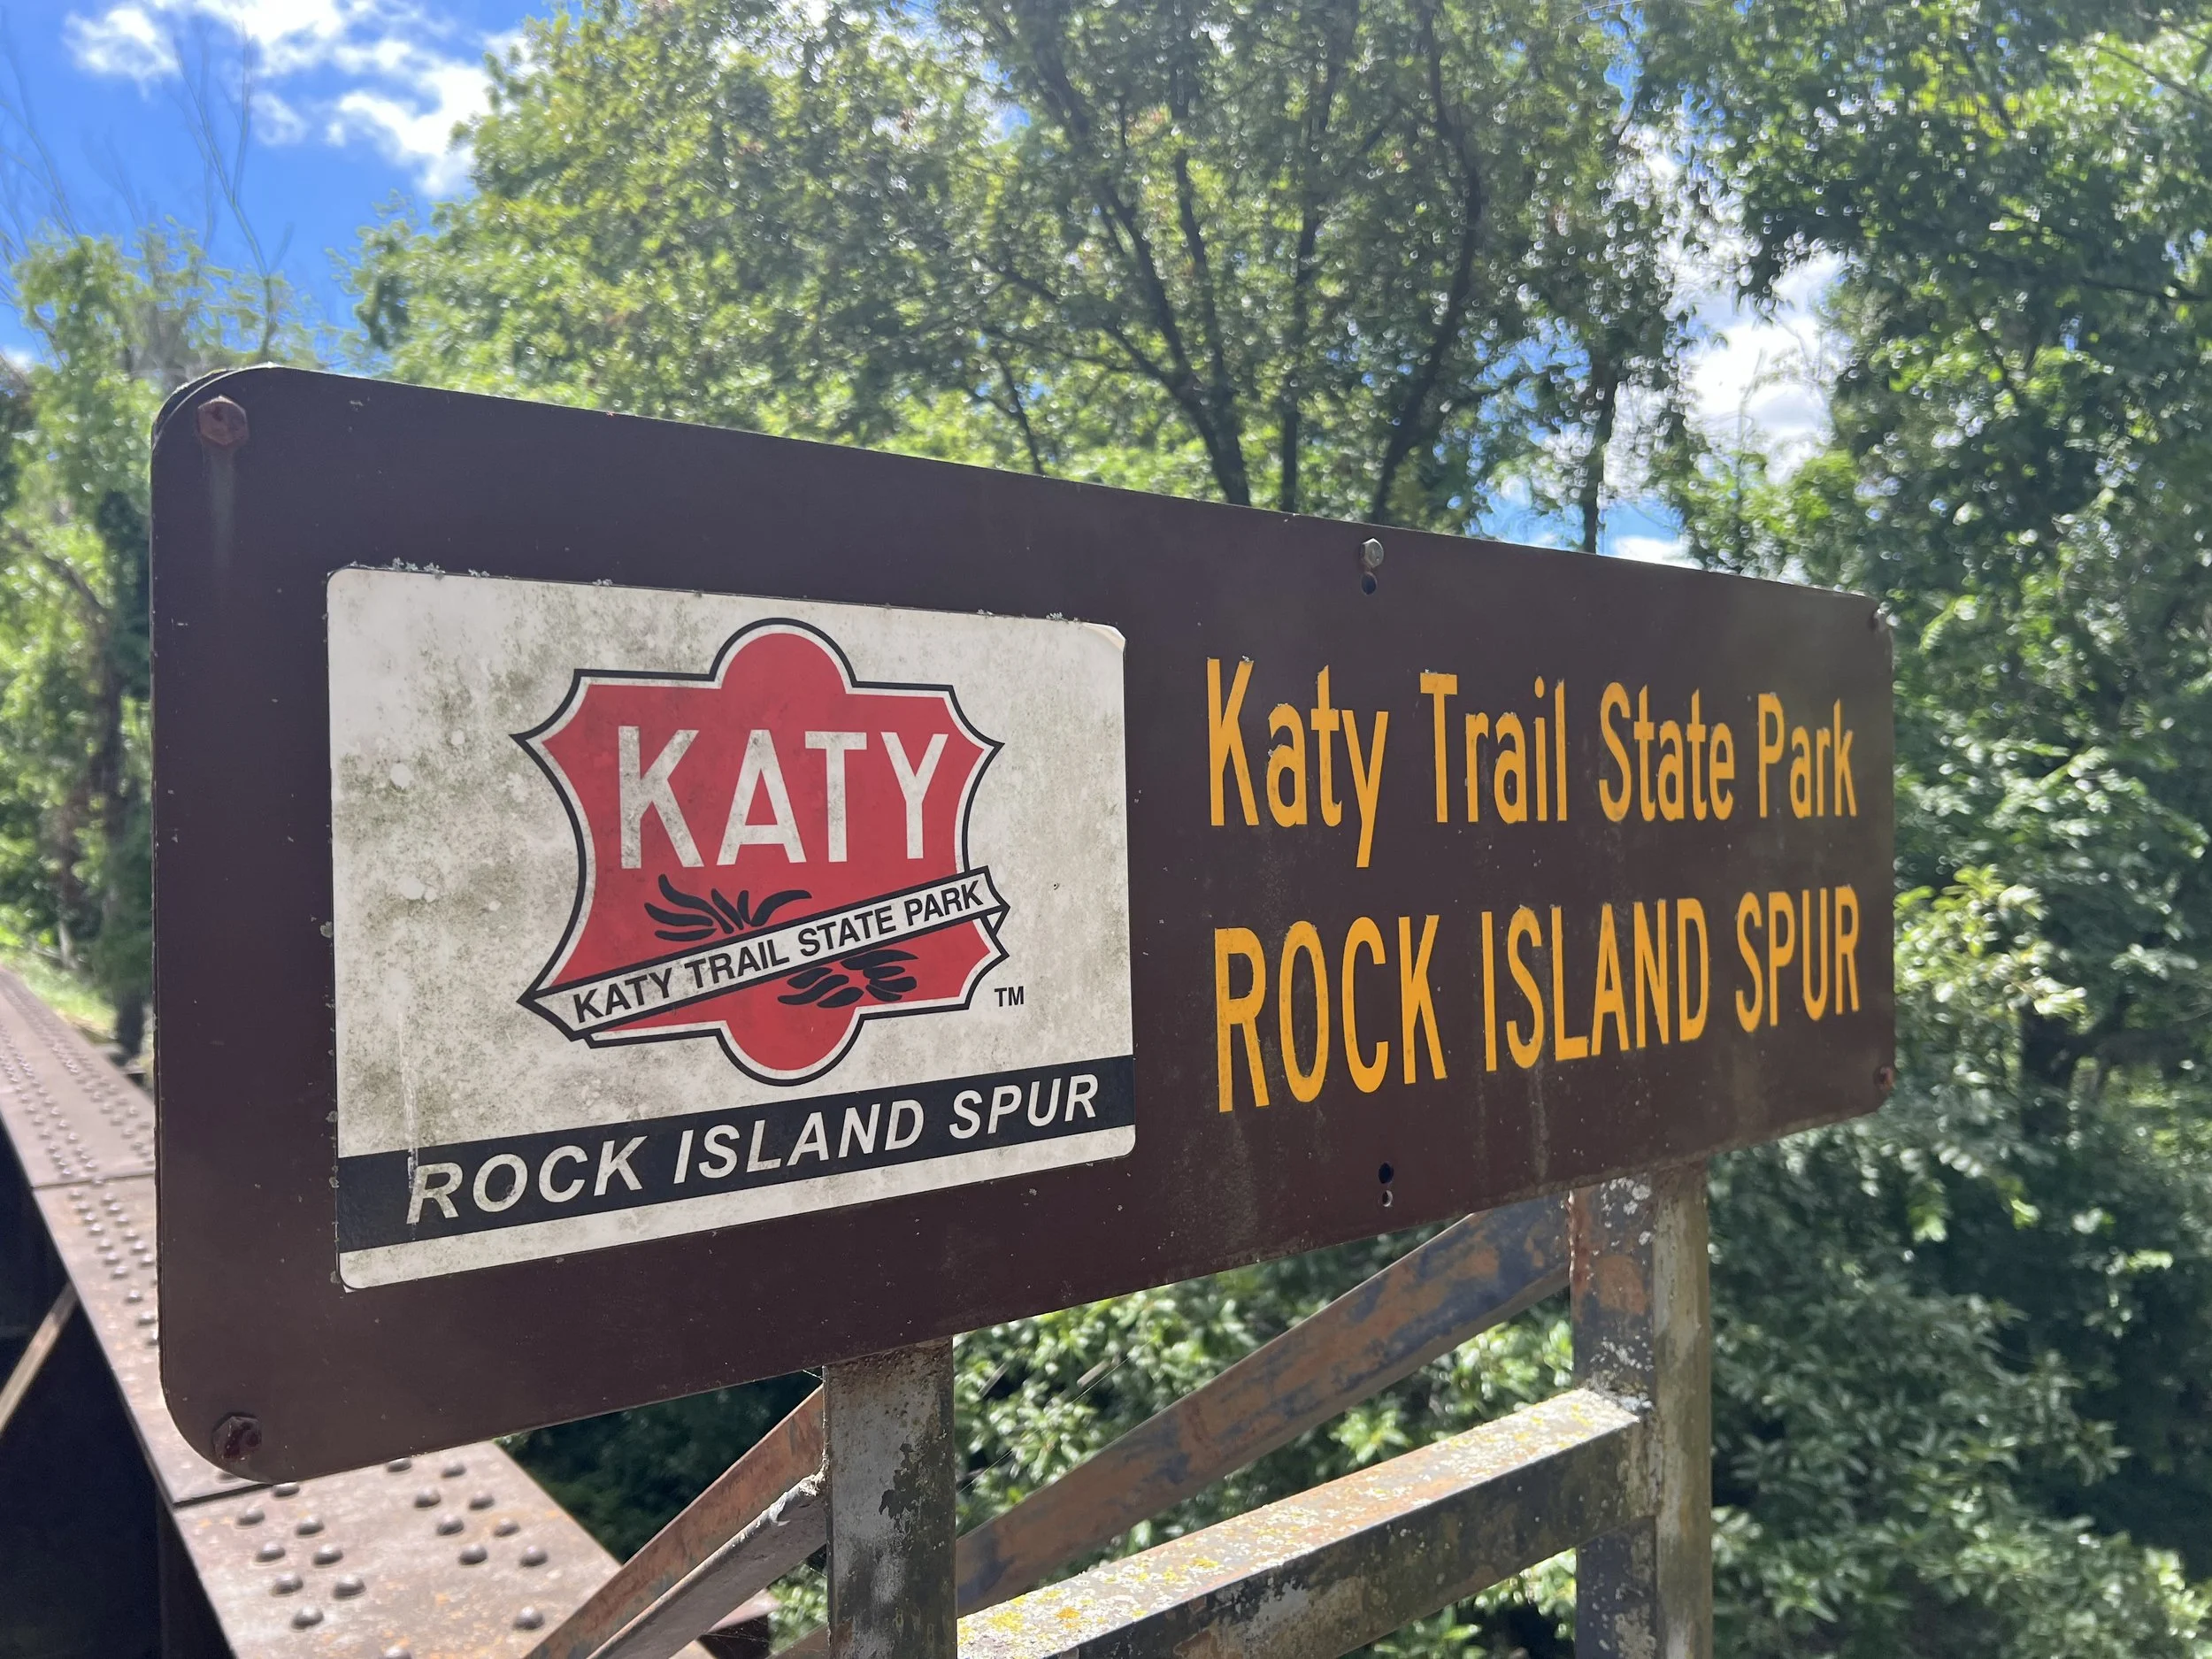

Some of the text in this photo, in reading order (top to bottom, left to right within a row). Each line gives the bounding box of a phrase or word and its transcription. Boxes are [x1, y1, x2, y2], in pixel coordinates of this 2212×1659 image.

[618, 726, 949, 870] KATY
[1206, 657, 1857, 868] Katy Trail State Park
[573, 880, 985, 1024] KATY TRAIL STATE PARK
[994, 986, 1025, 1008] TM
[1214, 885, 1860, 1112] ROCK ISLAND SPUR
[404, 1073, 1100, 1225] ROCK ISLAND SPUR
